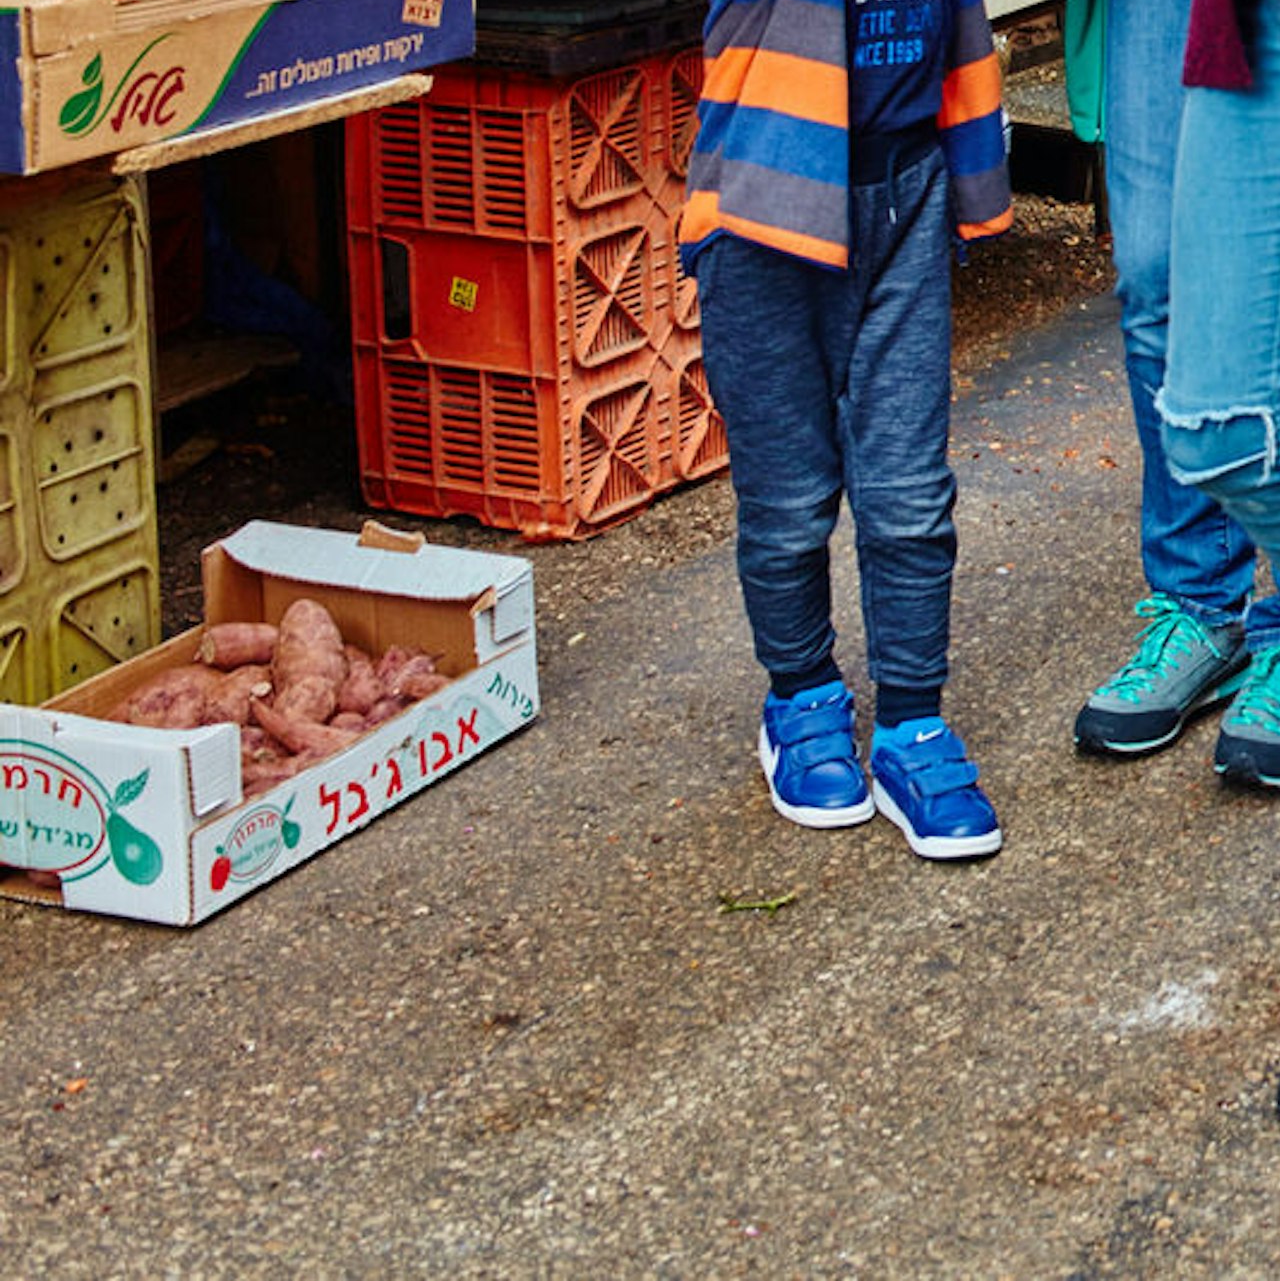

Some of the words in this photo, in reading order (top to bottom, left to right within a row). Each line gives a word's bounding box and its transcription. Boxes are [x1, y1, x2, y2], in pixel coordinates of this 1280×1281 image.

[383, 32, 424, 63] ירקות
[486, 671, 534, 719] פירות
[417, 707, 480, 777] אבו
